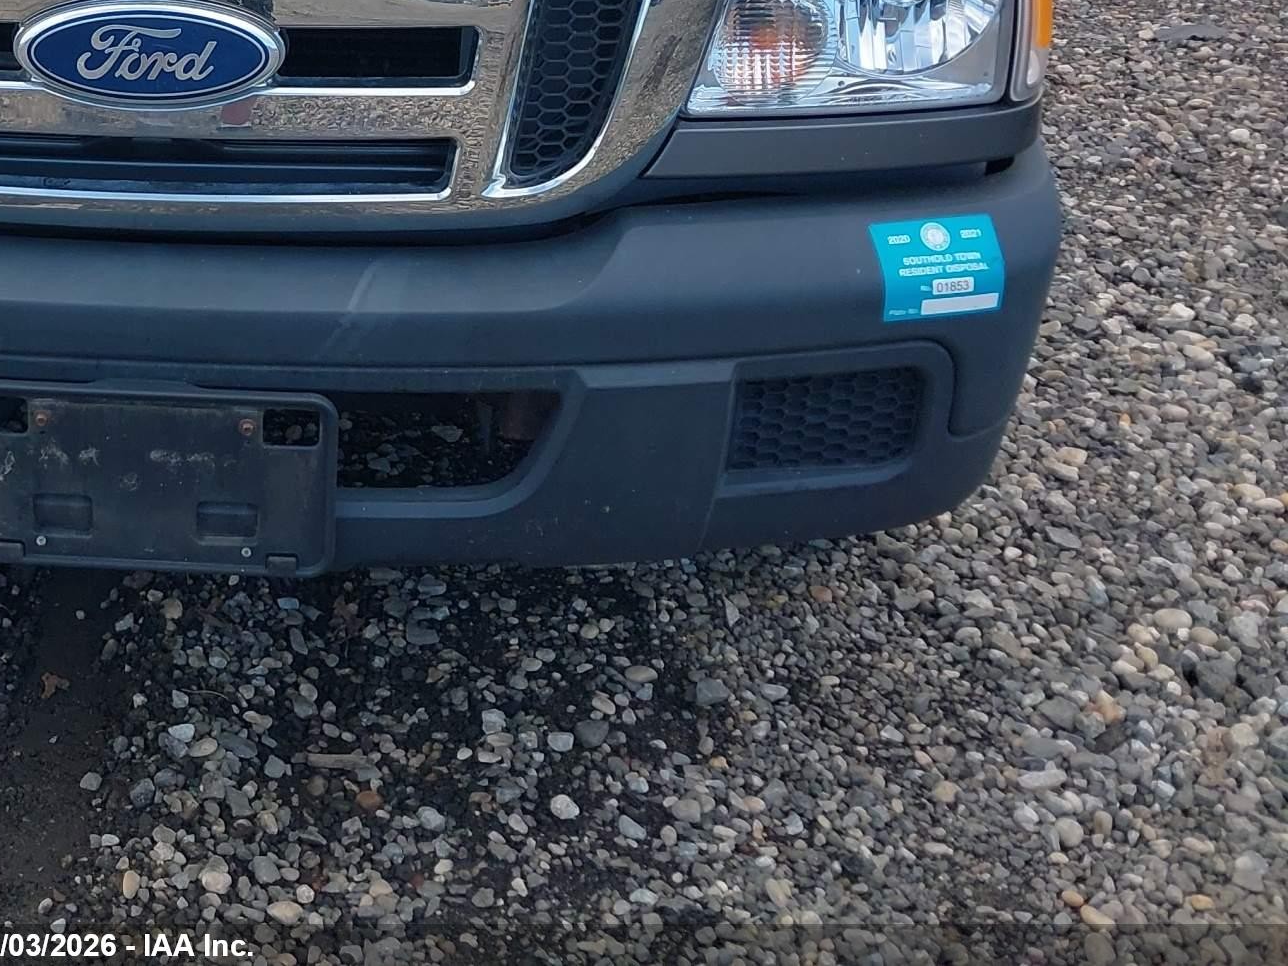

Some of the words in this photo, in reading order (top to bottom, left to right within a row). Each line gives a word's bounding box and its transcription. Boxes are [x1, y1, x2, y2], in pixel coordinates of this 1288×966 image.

[76, 24, 217, 81] Ford
[903, 254, 952, 265] SOUTHOLD
[955, 252, 981, 261] TOWN
[899, 266, 943, 276] RESIDENT
[945, 262, 989, 273] DISPOSAL
[936, 281, 969, 292] 01853
